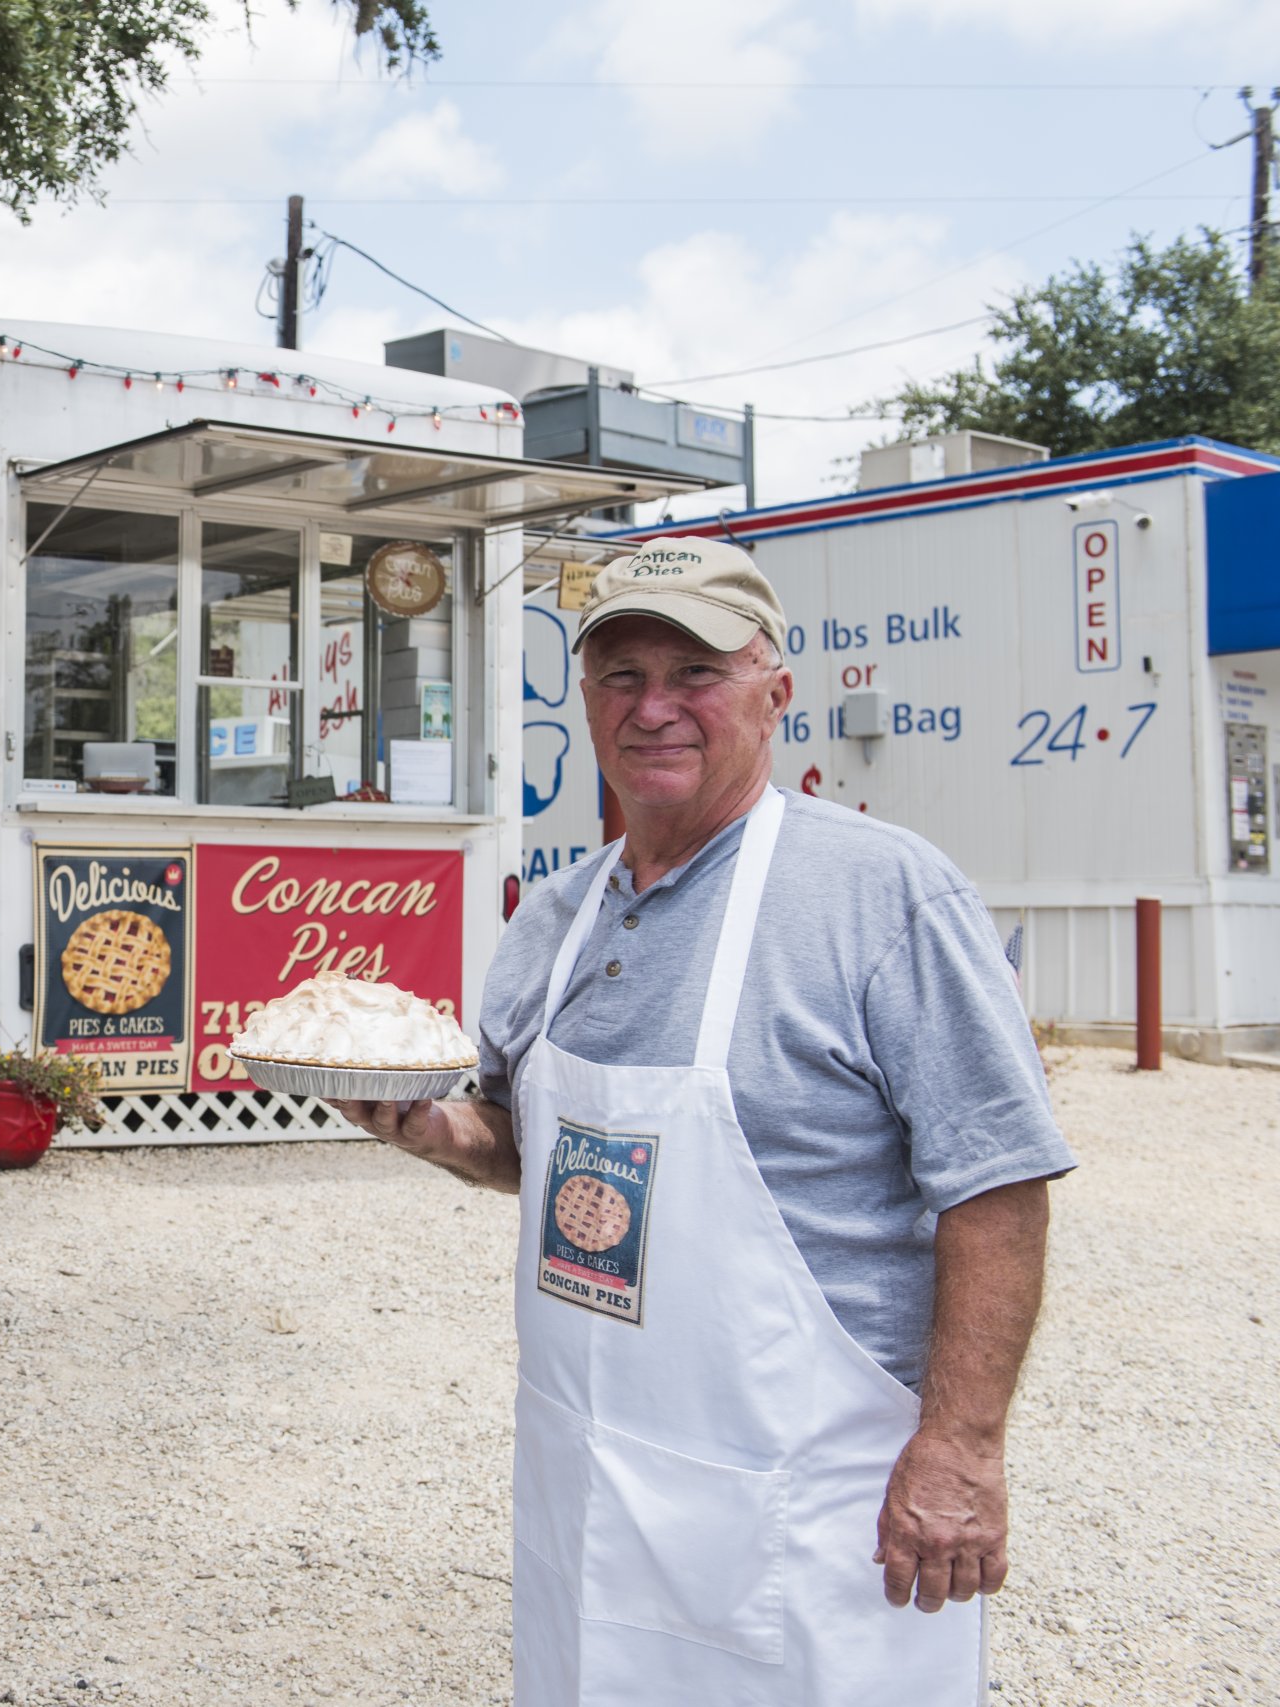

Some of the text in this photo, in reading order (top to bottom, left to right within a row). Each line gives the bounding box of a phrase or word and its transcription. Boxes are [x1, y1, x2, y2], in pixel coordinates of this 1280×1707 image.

[628, 551, 702, 569] Concan
[631, 565, 684, 578] Pies
[1083, 531, 1109, 663] OPEN
[824, 618, 869, 652] lbs
[886, 605, 961, 645] Bulk
[842, 663, 878, 689] or
[893, 702, 962, 742] Bag
[49, 861, 181, 923] Delicious
[231, 856, 438, 917] Concan
[278, 922, 391, 984] Pies
[69, 1017, 165, 1036] PIES & CAKES
[135, 1059, 180, 1076] PIES
[555, 1135, 644, 1185] Delicious
[556, 1244, 620, 1275] PIES & CAKES
[543, 1270, 632, 1310] CONCAN PIES
